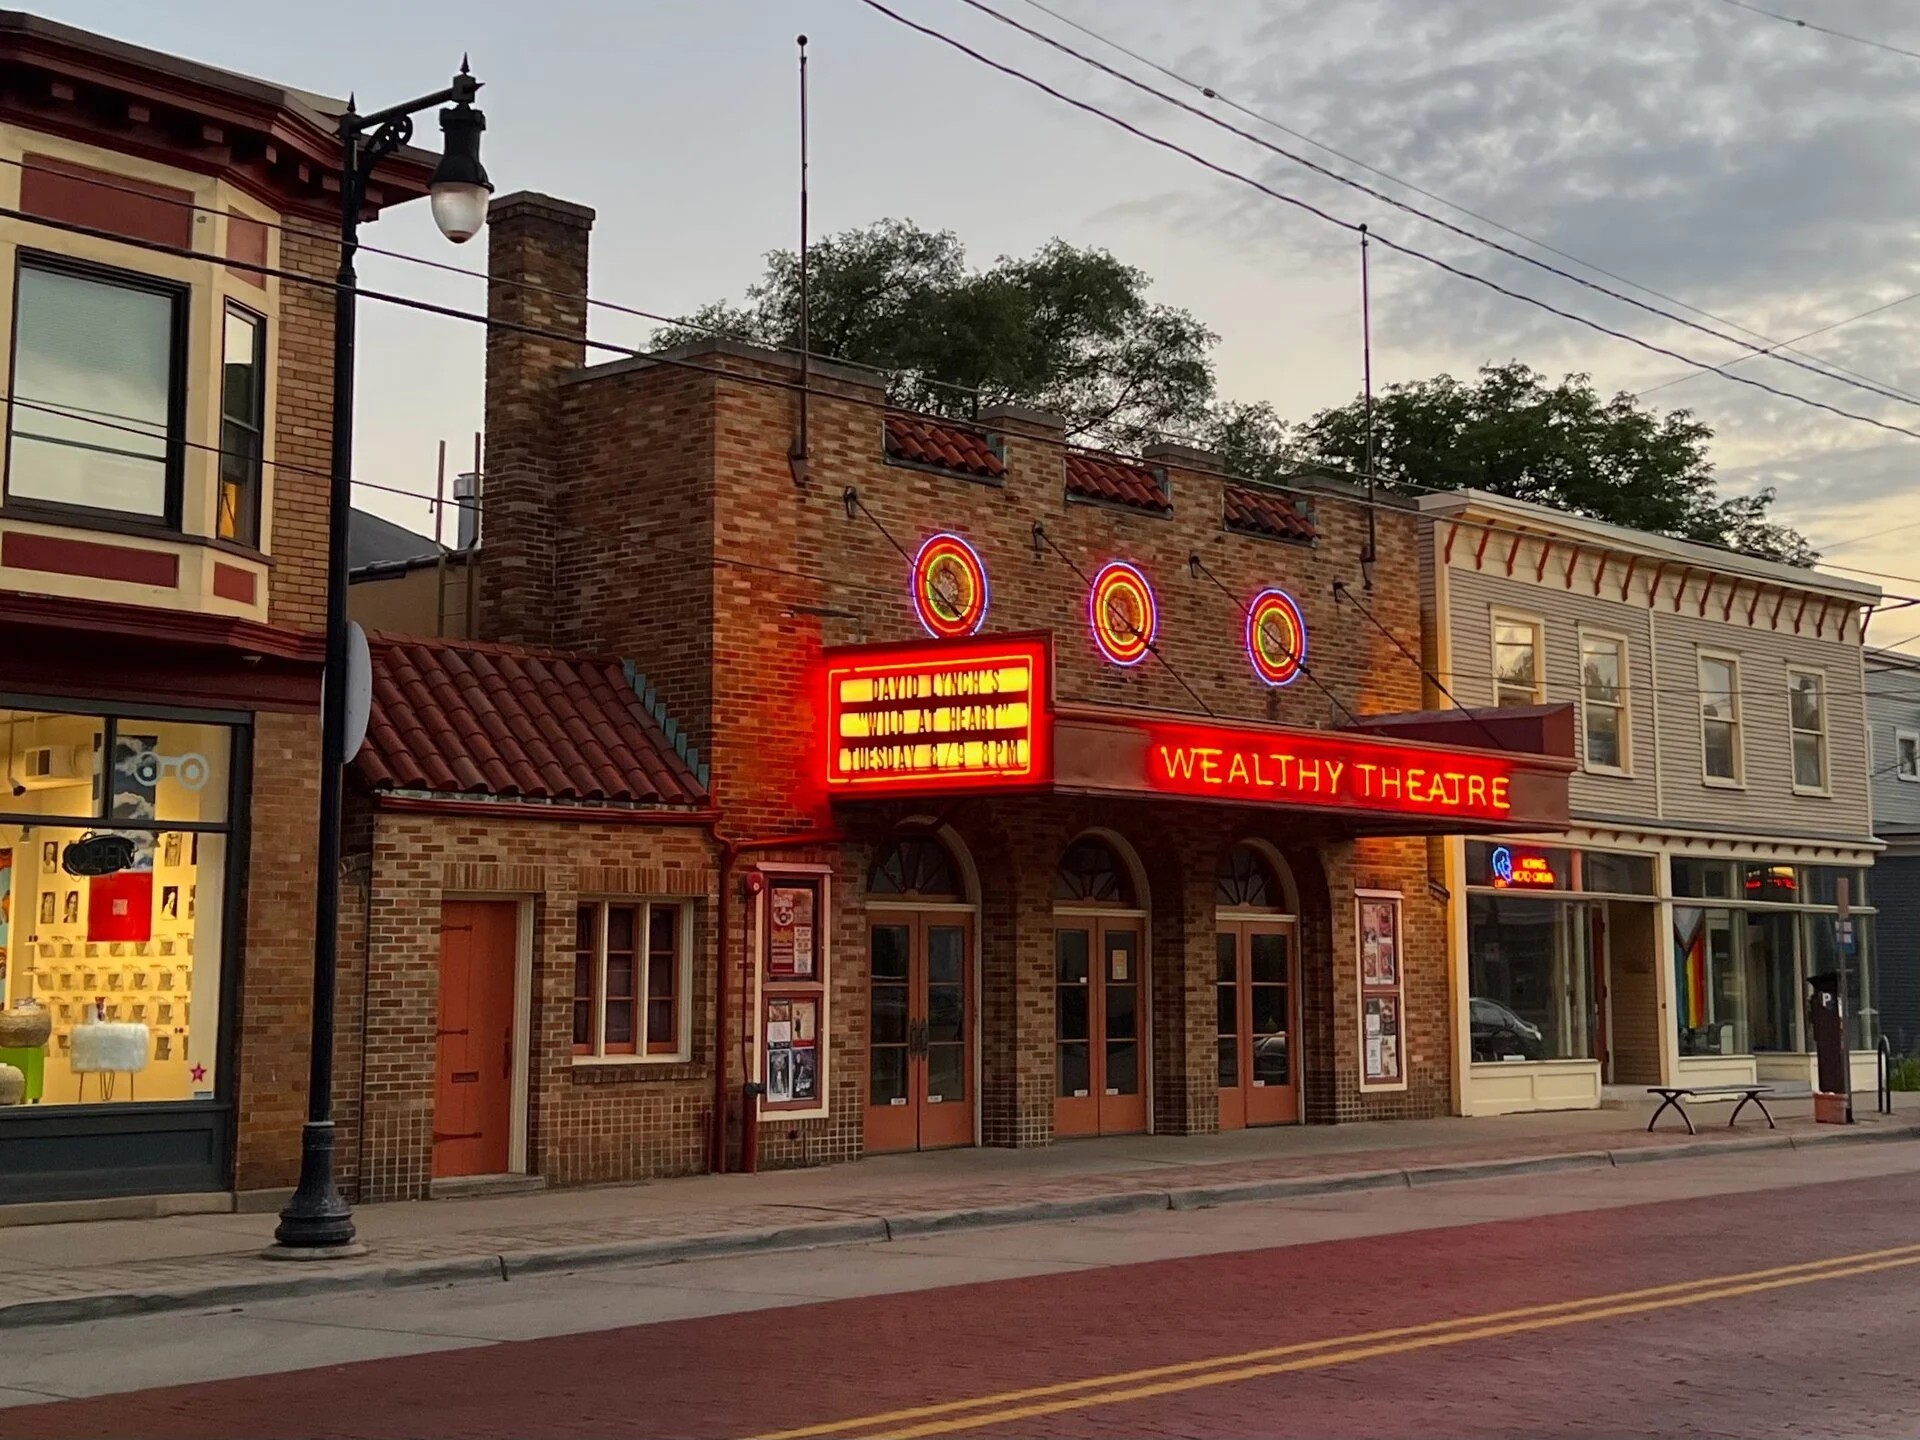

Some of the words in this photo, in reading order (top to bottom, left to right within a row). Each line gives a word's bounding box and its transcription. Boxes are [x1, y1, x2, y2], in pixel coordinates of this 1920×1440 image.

[872, 675, 918, 700] DAVID
[918, 709, 937, 733] AT
[848, 744, 914, 770] TUESDAY
[931, 743, 965, 767] 8/9
[1160, 746, 1343, 794] WEALTHY
[1354, 764, 1511, 808] THEATRE
[69, 843, 133, 871] OPEN
[1822, 992, 1831, 1007] P
